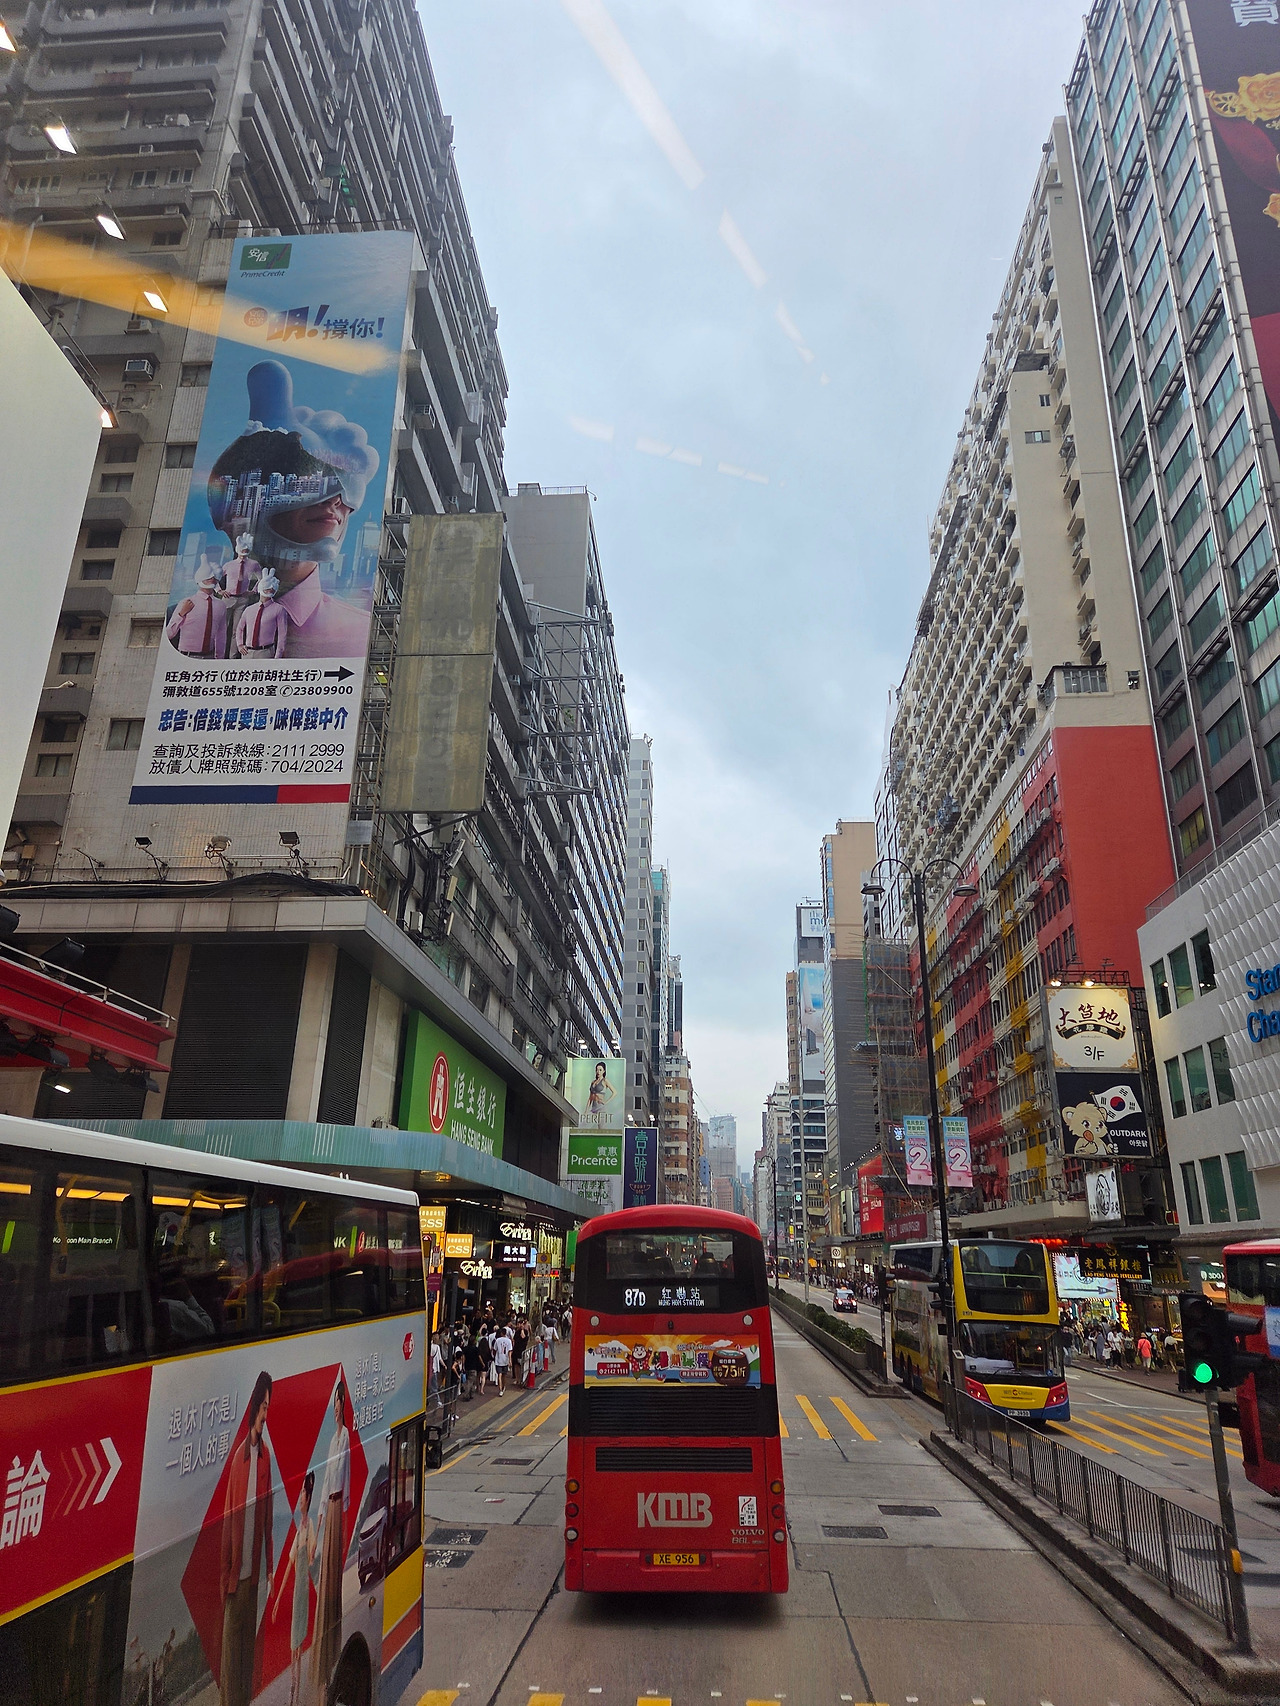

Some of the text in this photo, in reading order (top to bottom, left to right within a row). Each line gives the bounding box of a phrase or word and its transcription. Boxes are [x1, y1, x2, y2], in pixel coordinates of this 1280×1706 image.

[248, 248, 270, 262] 安信
[240, 270, 285, 278] PrimeCredit
[162, 685, 353, 698] 彌敦道655號1208室 23809900
[309, 743, 345, 757] 2999
[1084, 1045, 1105, 1060] 3/F
[454, 1066, 497, 1129] 恒生銀行
[451, 1119, 495, 1157] HANG SENG BANK
[1110, 1129, 1147, 1138] OUTDARK
[597, 1146, 618, 1157] 實惠
[909, 1146, 929, 1170] 2
[571, 1154, 618, 1166] Pricerite
[948, 1147, 969, 1172] 2
[447, 1245, 470, 1254] CSS
[625, 1288, 646, 1306] 87D
[682, 1299, 705, 1307] STATION
[167, 1391, 239, 1441] 退休「不是」
[165, 1429, 232, 1476] 一個人的事
[0, 1449, 51, 1550] 論
[637, 1492, 713, 1528] KMB
[659, 1555, 694, 1564] XE 956
